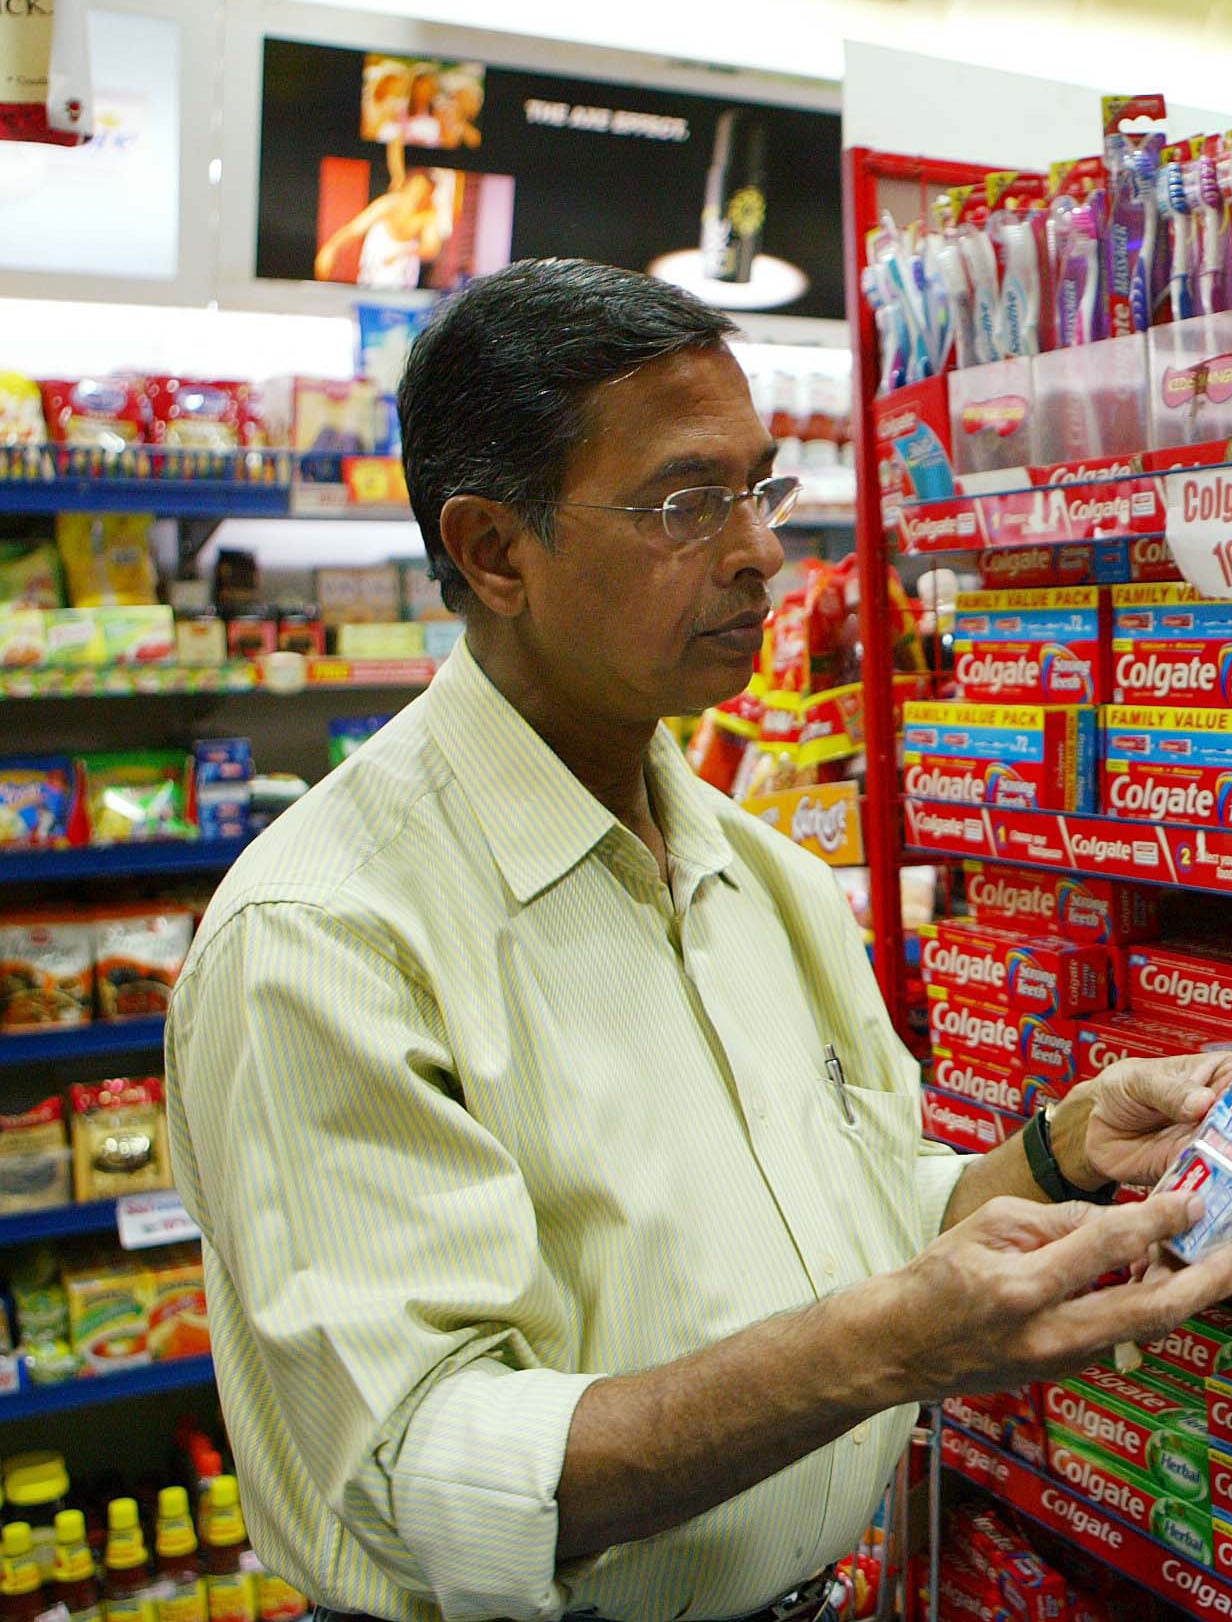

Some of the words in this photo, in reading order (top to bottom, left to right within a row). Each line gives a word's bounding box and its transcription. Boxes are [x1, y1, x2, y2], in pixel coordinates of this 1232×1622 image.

[524, 99, 570, 127] THE
[956, 652, 1039, 693] Colgate
[1115, 653, 1217, 698] Colgate
[1110, 710, 1165, 727] FAMILY
[1173, 713, 1228, 730] VALUE
[1110, 775, 1214, 819] Colgate
[1181, 847, 1191, 865] 2
[923, 939, 1006, 987] Colgate
[1047, 1386, 1141, 1454] Colgate
[1051, 1448, 1145, 1520] Colgate
[1160, 1452, 1202, 1485] Herbal
[1165, 1520, 1203, 1551] Herbal
